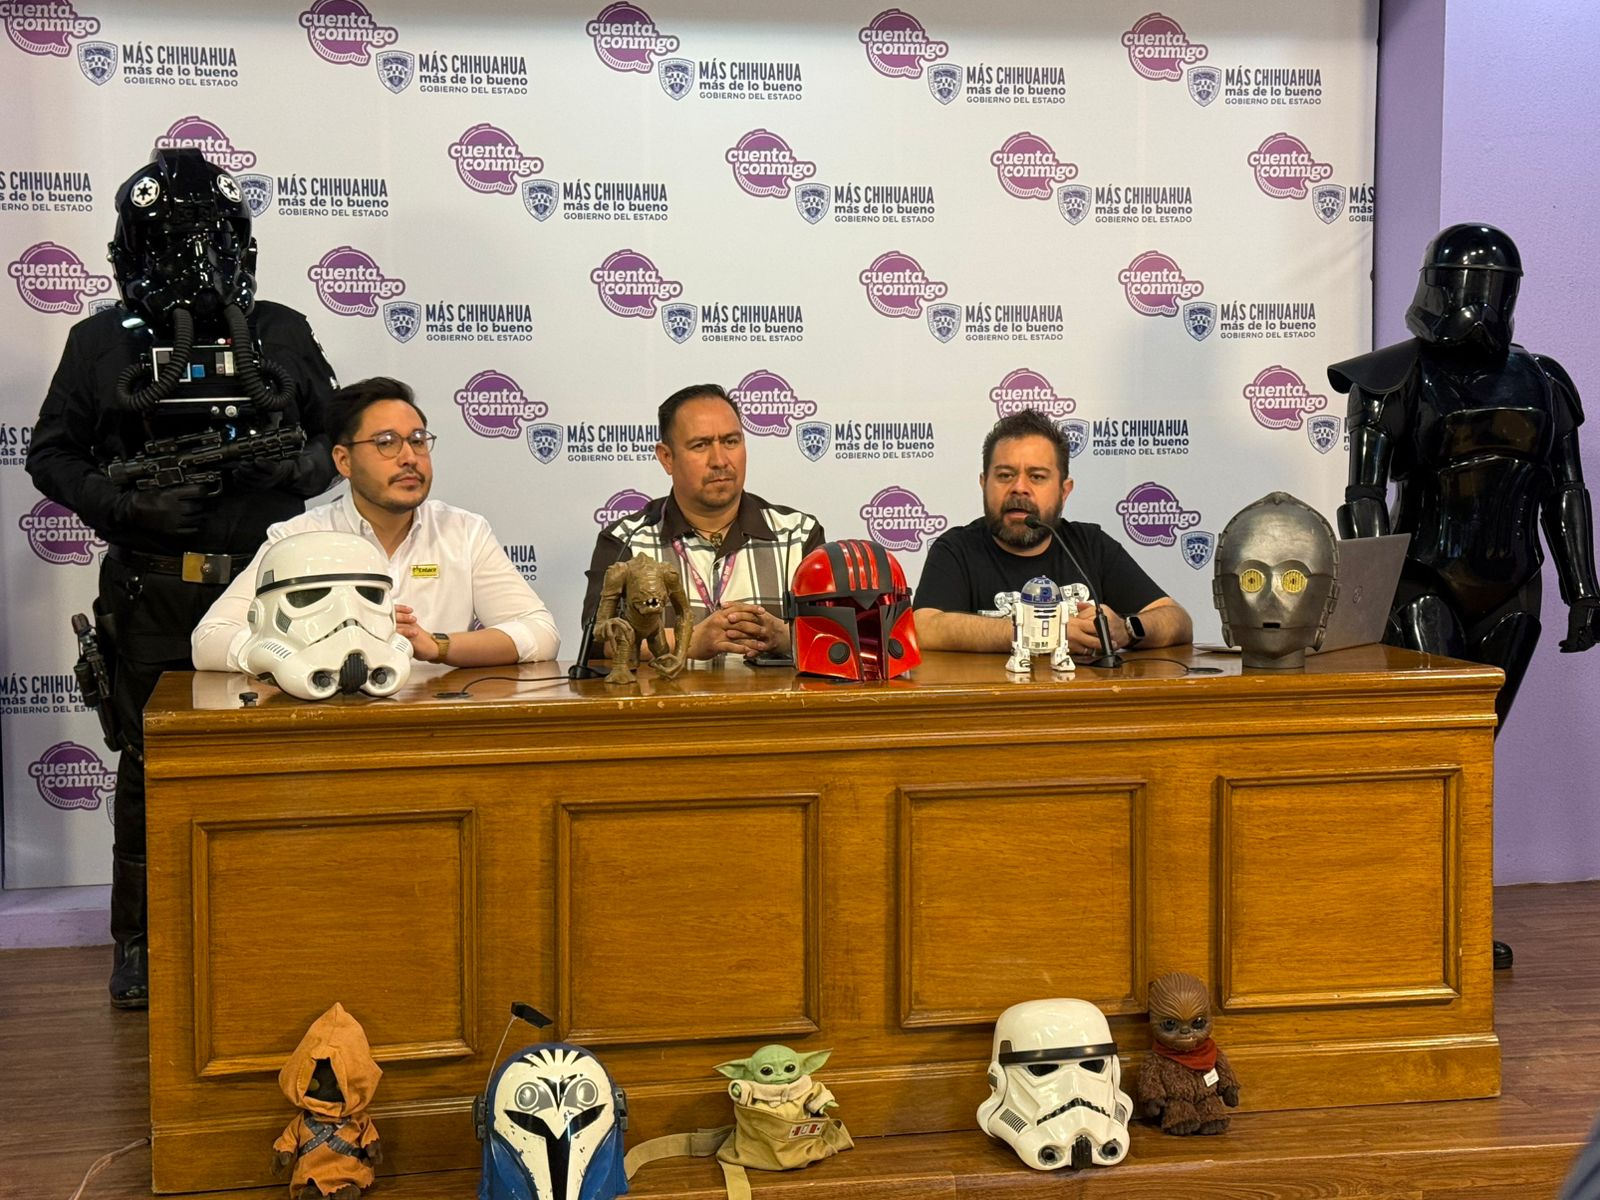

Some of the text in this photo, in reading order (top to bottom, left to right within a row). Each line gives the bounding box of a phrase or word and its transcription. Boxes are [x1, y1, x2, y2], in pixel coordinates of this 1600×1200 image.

[0, 1, 71, 18] cuenta
[12, 15, 98, 36] conmigo
[302, 11, 370, 28] cuenta
[315, 25, 396, 46] conmigo
[589, 21, 653, 36] cuenta
[861, 28, 923, 42] cuenta
[601, 34, 678, 53] conmigo
[1123, 32, 1184, 46] cuenta
[122, 41, 237, 67] MÁS CHIHUAHUA
[872, 41, 947, 59] conmigo
[1134, 44, 1206, 61] conmigo
[123, 63, 238, 77] más de lo bueno
[419, 50, 527, 75] MÁS CHIHUAHUA
[699, 58, 801, 81] MÁS CHIHUAHUA
[124, 76, 238, 87] GOBIERNO DEL ESTADO
[966, 63, 1065, 85] MÁS CHIHUAHUA
[1225, 65, 1322, 86] MÁS CHIHUAHUA
[419, 85, 527, 95] GOBIERNO DEL ESTADO
[699, 79, 802, 92] más de lo bueno
[966, 84, 1066, 95] más de lo bueno
[450, 143, 516, 158] cuenta
[727, 148, 790, 162] cuenta
[992, 151, 1053, 165] cuenta
[1249, 151, 1309, 165] cuenta
[463, 156, 541, 175] conmigo
[739, 161, 814, 179] conmigo
[1003, 163, 1076, 180] conmigo
[1260, 163, 1331, 181] conmigo
[9, 171, 92, 192] CHIHUAHUA
[277, 174, 388, 197] MÁS CHIHUAHUA
[563, 179, 667, 201] MÁS CHIHUAHUA
[9, 191, 93, 202] de lo bueno
[834, 182, 934, 204] MÁS CHIHUAHUA
[1095, 184, 1192, 204] MÁS CHIHUAHUA
[1349, 183, 1375, 203] MÁS
[278, 208, 329, 216] GOBIERNO
[352, 209, 389, 217] ESTADO
[564, 200, 668, 212] más de lo bueno
[834, 203, 935, 214] más de lo bueno
[1349, 203, 1373, 213] más
[564, 212, 611, 220] GOBIERNO
[633, 213, 668, 221] ESTADO
[10, 262, 82, 277] cuenta
[310, 266, 378, 280] cuenta
[593, 268, 657, 282] cuenta
[861, 269, 923, 283] cuenta
[1120, 269, 1180, 283] cuenta
[24, 275, 109, 294] conmigo
[323, 279, 403, 297] conmigo
[605, 281, 681, 298] conmigo
[873, 282, 946, 299] conmigo
[1131, 281, 1202, 298] conmigo
[426, 301, 532, 322] MÁS CHIHUAHUA
[701, 302, 803, 323] MÁS CHIHUAHUA
[965, 302, 1063, 322] MÁS CHIHUAHUA
[1220, 300, 1316, 320] MÁS CHIHUAHUA
[426, 322, 533, 332] más de lo bueno
[1220, 320, 1316, 330] más de lo bueno
[456, 389, 521, 403] cuenta
[730, 388, 792, 403] cuenta
[991, 386, 1051, 401] cuenta
[1245, 383, 1303, 397] cuenta
[468, 401, 546, 419] conmigo
[741, 400, 815, 418] conmigo
[1002, 398, 1074, 416] conmigo
[1256, 394, 1325, 412] conmigo
[567, 422, 661, 442] MÁS CHIHUAHU
[835, 420, 934, 440] MÁS CHIHUAHUA
[1093, 417, 1189, 437] MÁS CHIHUAHUA
[568, 442, 654, 453] más de lo bue
[835, 440, 934, 450] más de lo bueno
[1093, 448, 1136, 456] GOBIERNO
[862, 504, 923, 518] cuenta
[1118, 499, 1177, 514] cuenta
[21, 514, 86, 529] cuent
[873, 515, 945, 533] conmigo
[1129, 510, 1199, 529] conmigo
[30, 694, 48, 704] de
[52, 693, 65, 704] lo
[52, 705, 71, 713] DEL
[31, 759, 101, 776] cuenta
[44, 771, 116, 792] conmig
